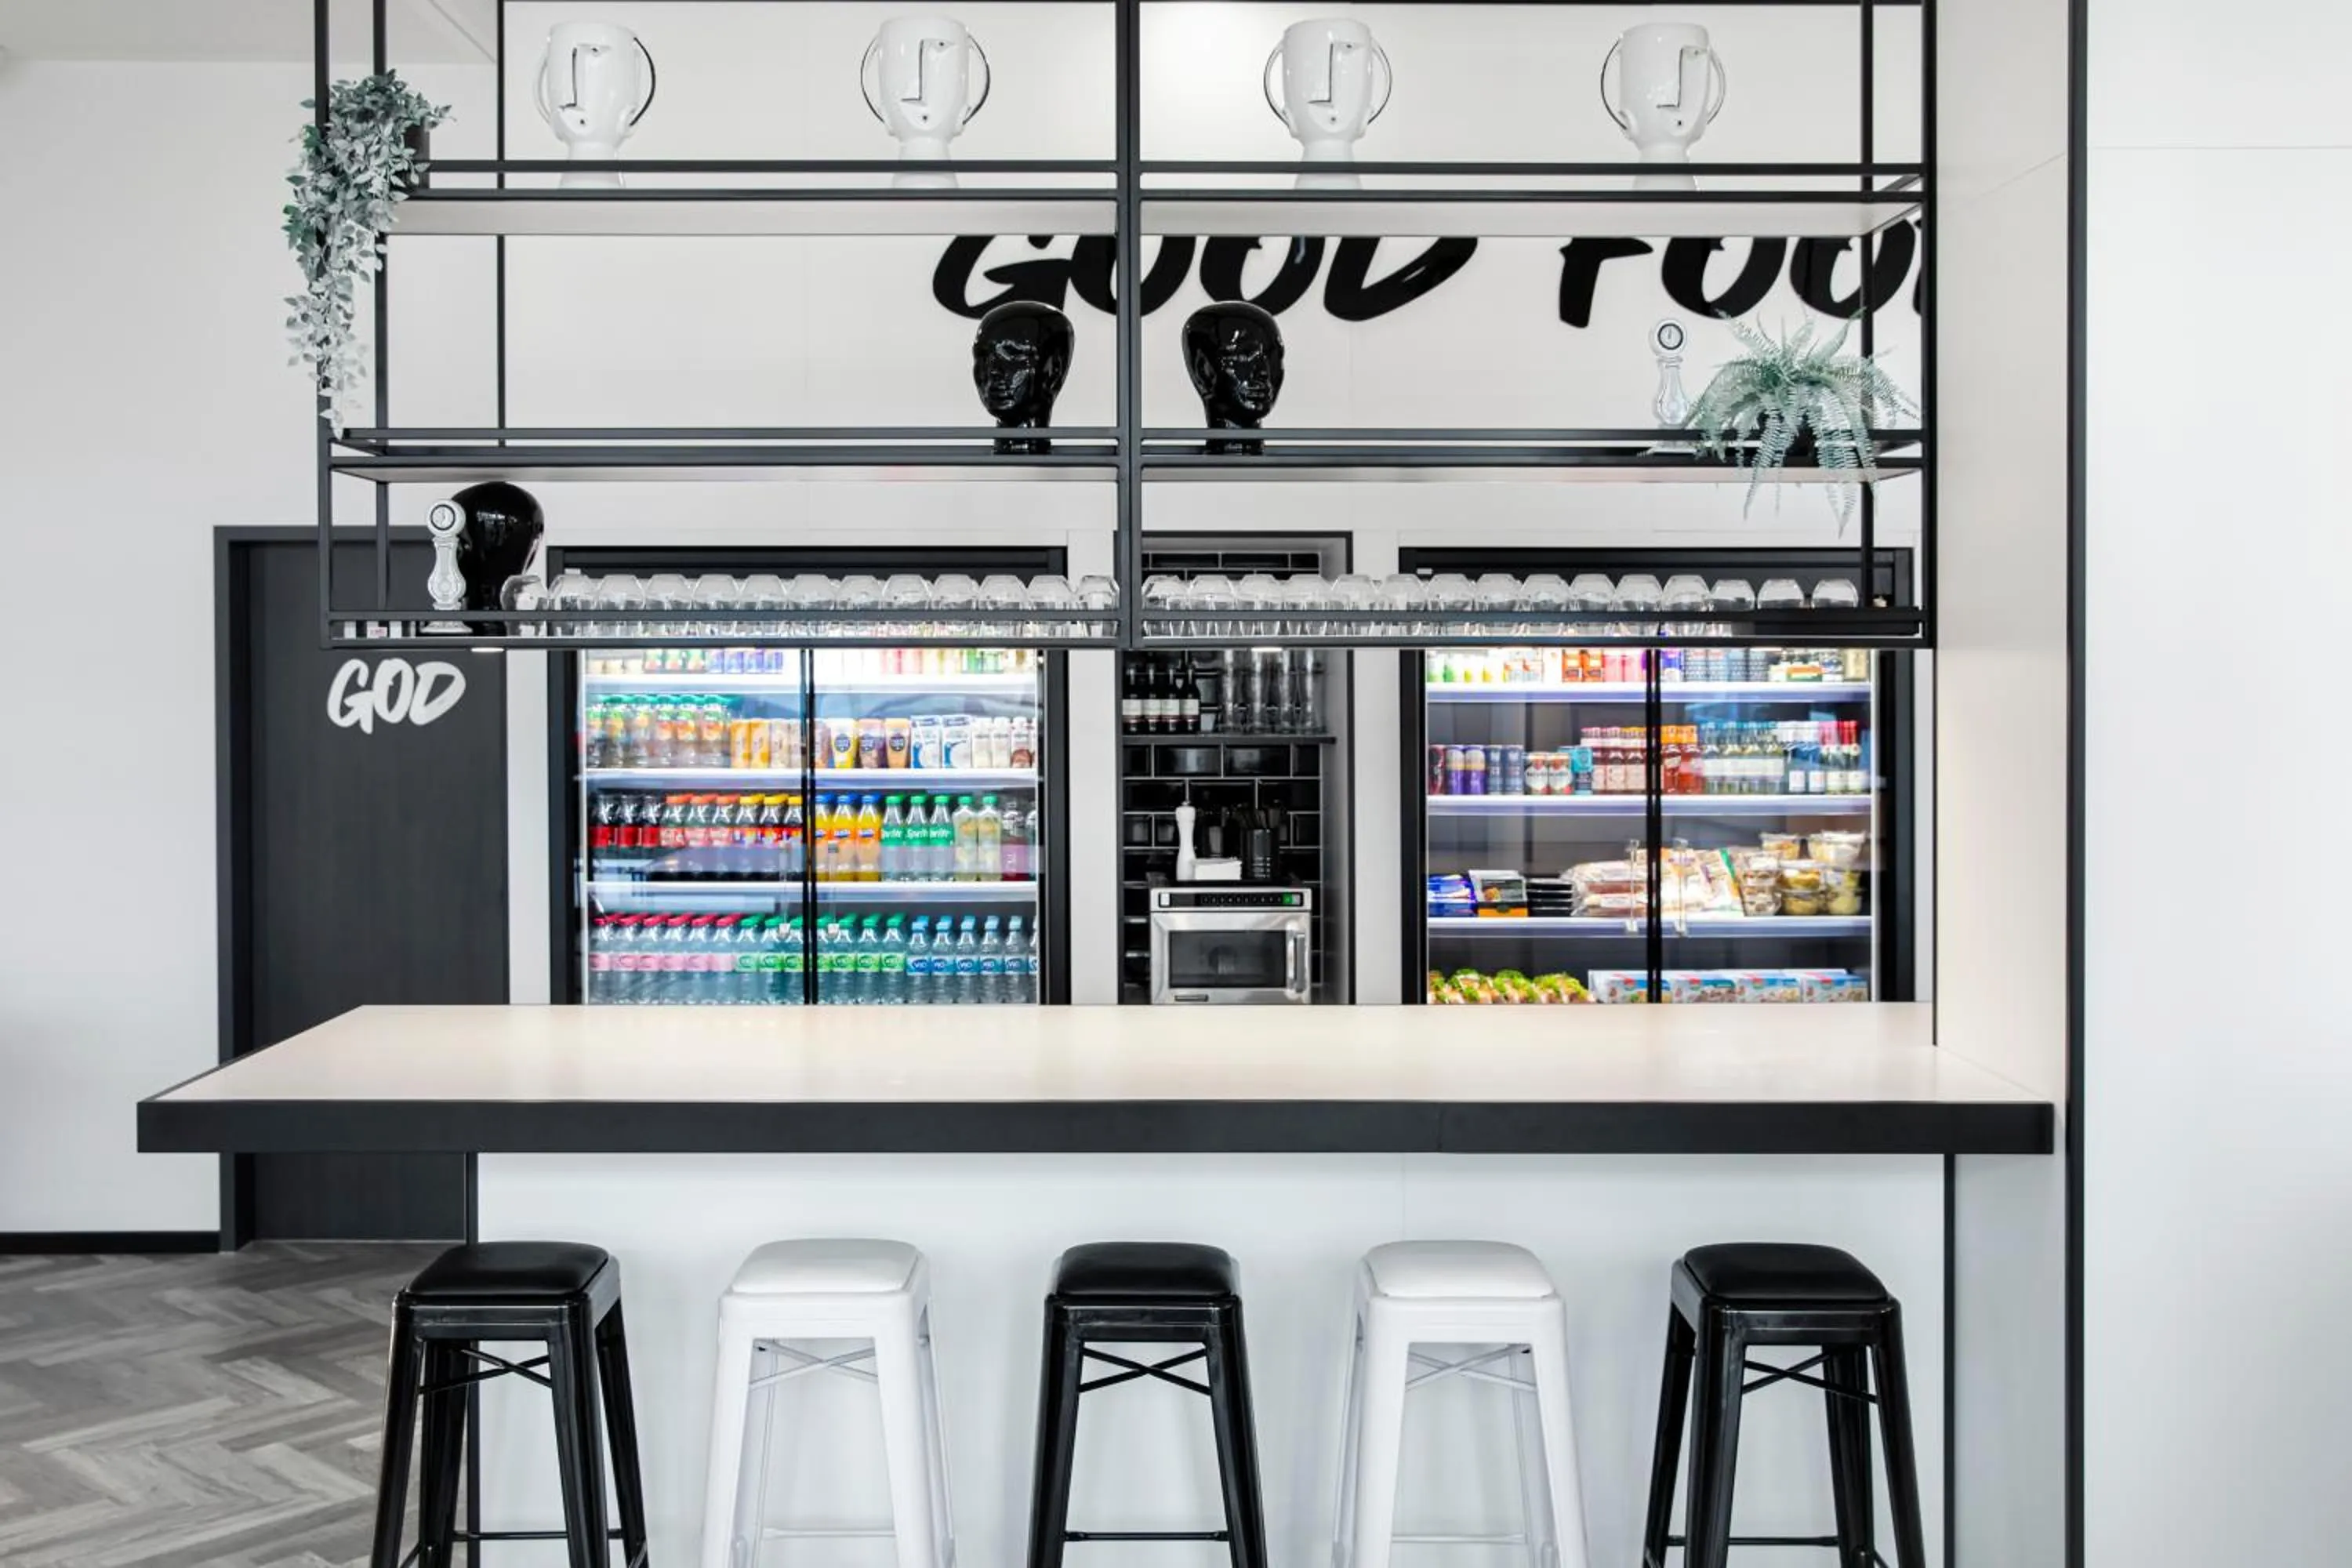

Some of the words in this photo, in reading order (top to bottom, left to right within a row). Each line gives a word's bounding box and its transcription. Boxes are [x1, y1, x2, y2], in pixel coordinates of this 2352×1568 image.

[933, 234, 1478, 321] GOOD
[1559, 219, 1922, 328] FOO
[327, 658, 466, 734] GOD
